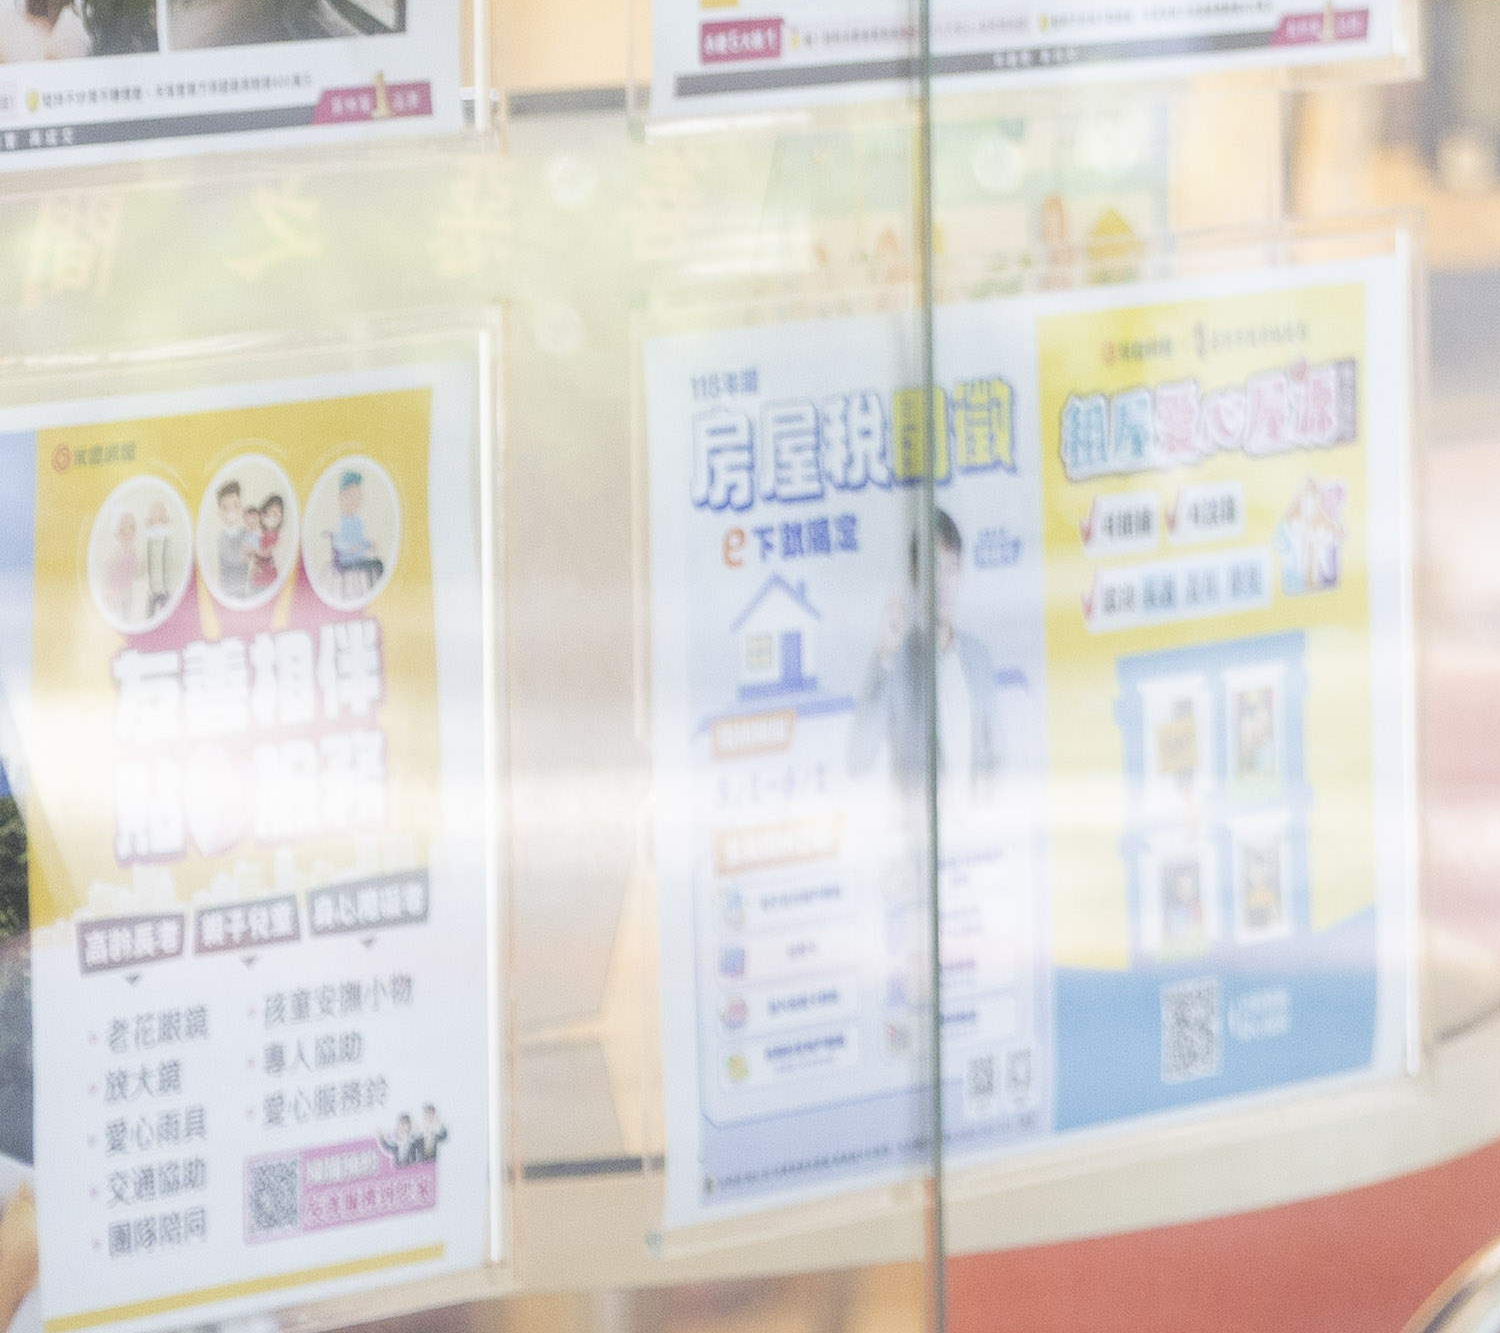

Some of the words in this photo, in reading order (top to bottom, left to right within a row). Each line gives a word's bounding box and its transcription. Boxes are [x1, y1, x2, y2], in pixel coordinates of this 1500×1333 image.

[263, 973, 416, 1029] 孩童安撫小物
[106, 1005, 209, 1055] 老花眼鏡
[263, 1030, 364, 1079] 專人協助
[104, 1060, 183, 1106] 放大鏡
[262, 1075, 391, 1131] 愛心服務鈴
[104, 1105, 208, 1158] 愛心雨具
[106, 1156, 208, 1209] 交通協助
[107, 1206, 209, 1259] 團隊陪同
